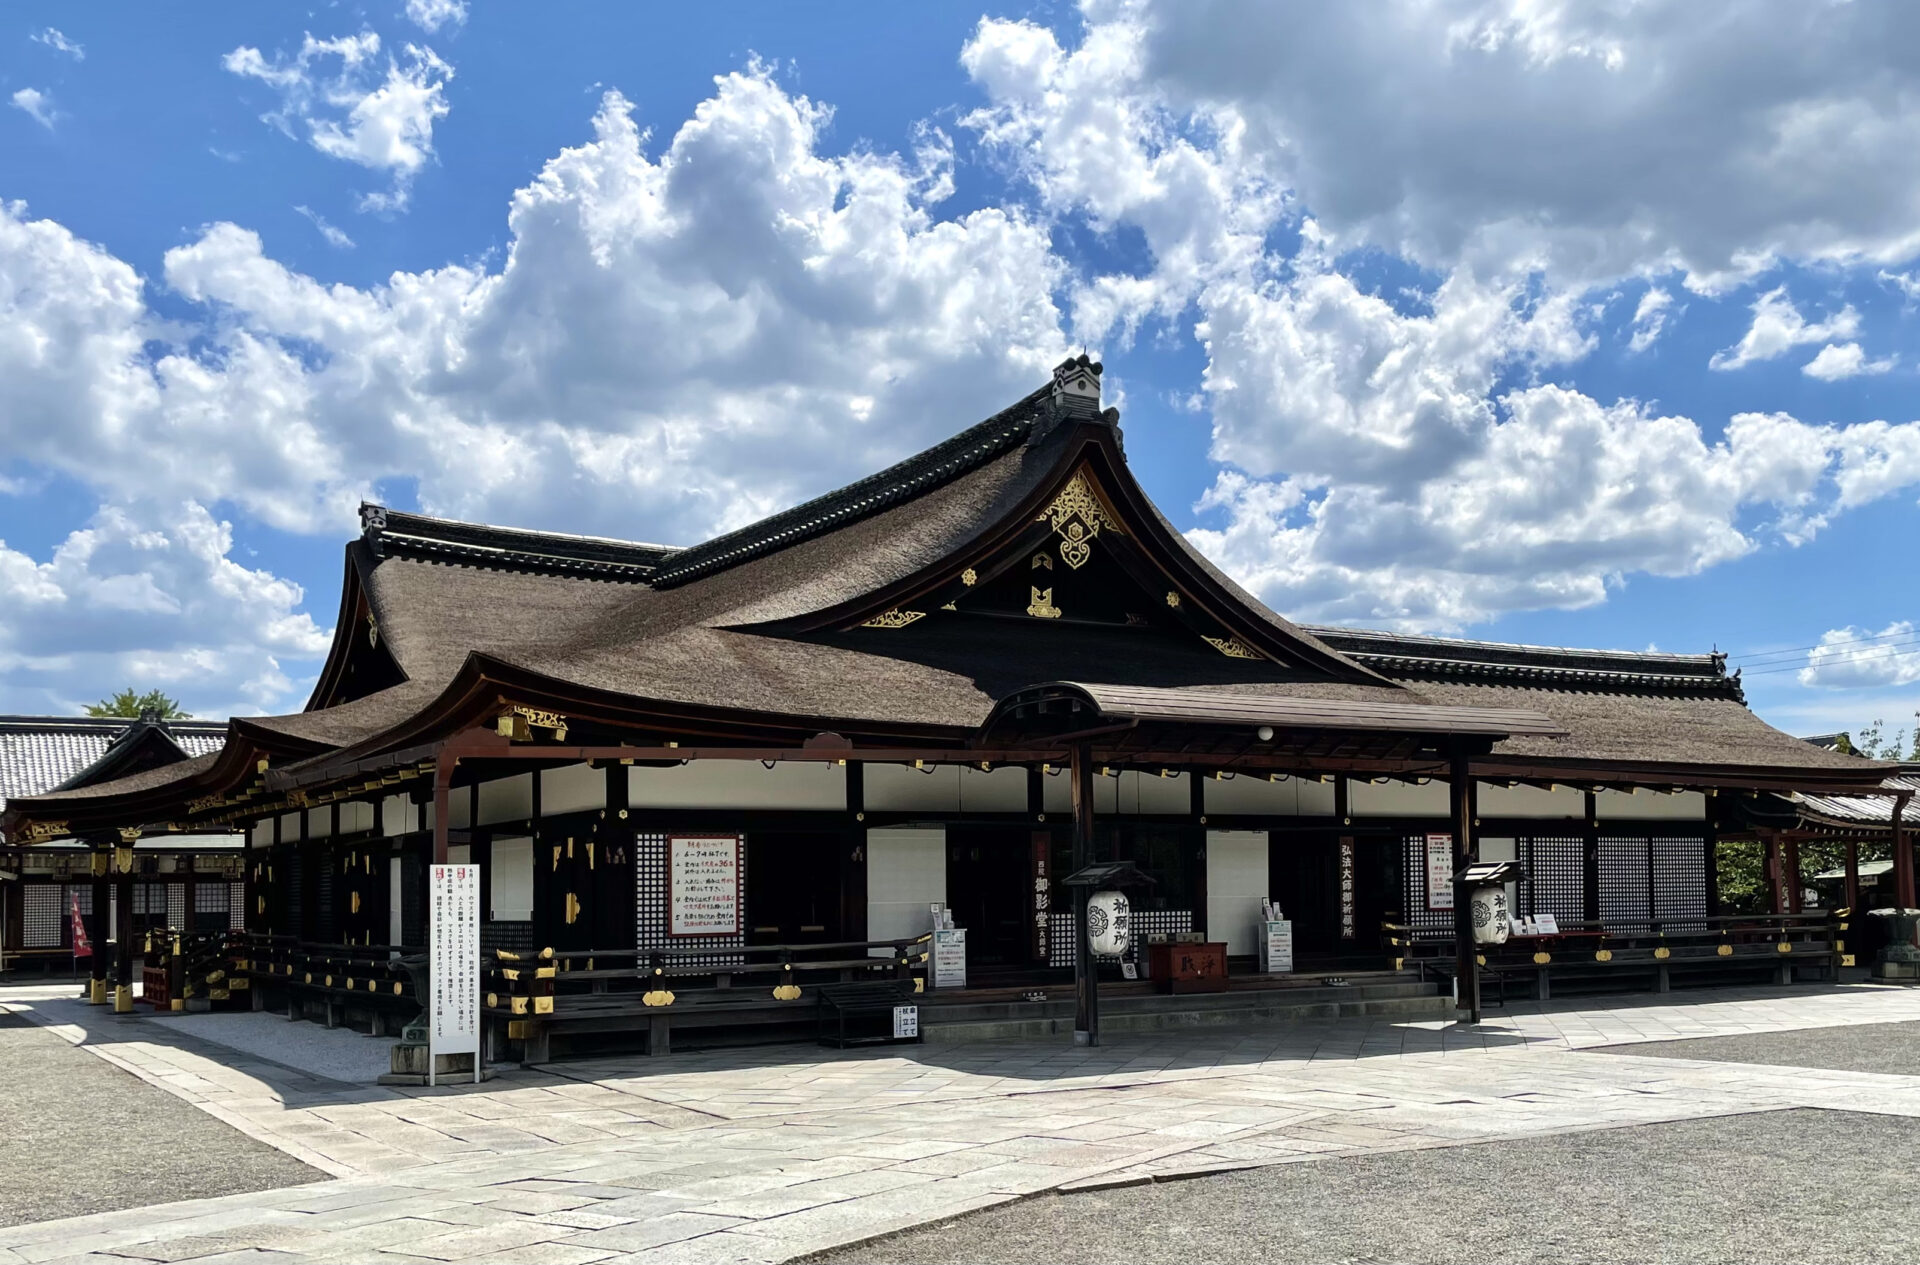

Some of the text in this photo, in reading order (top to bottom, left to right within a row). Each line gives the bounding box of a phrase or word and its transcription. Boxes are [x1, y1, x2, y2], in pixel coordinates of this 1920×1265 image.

[1341, 845, 1353, 936] 弘法大師御祈願所
[1112, 899, 1128, 945] 祈願所
[1494, 894, 1507, 935] 祈願所
